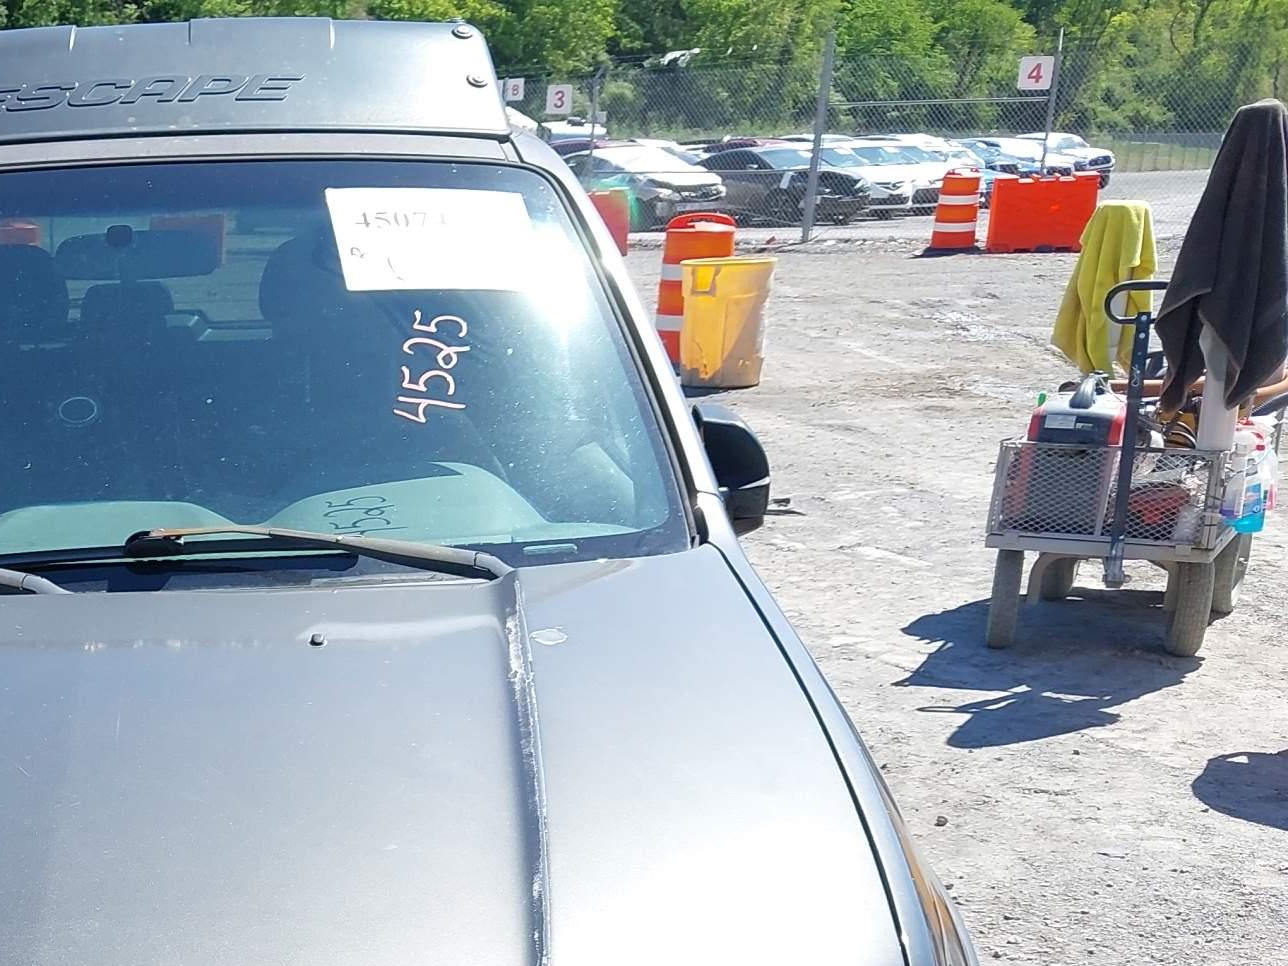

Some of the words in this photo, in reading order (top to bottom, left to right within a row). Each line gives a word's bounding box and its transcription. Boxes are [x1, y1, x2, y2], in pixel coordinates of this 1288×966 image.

[1027, 62, 1043, 84] 4
[553, 90, 565, 109] 3
[393, 310, 471, 424] 4525
